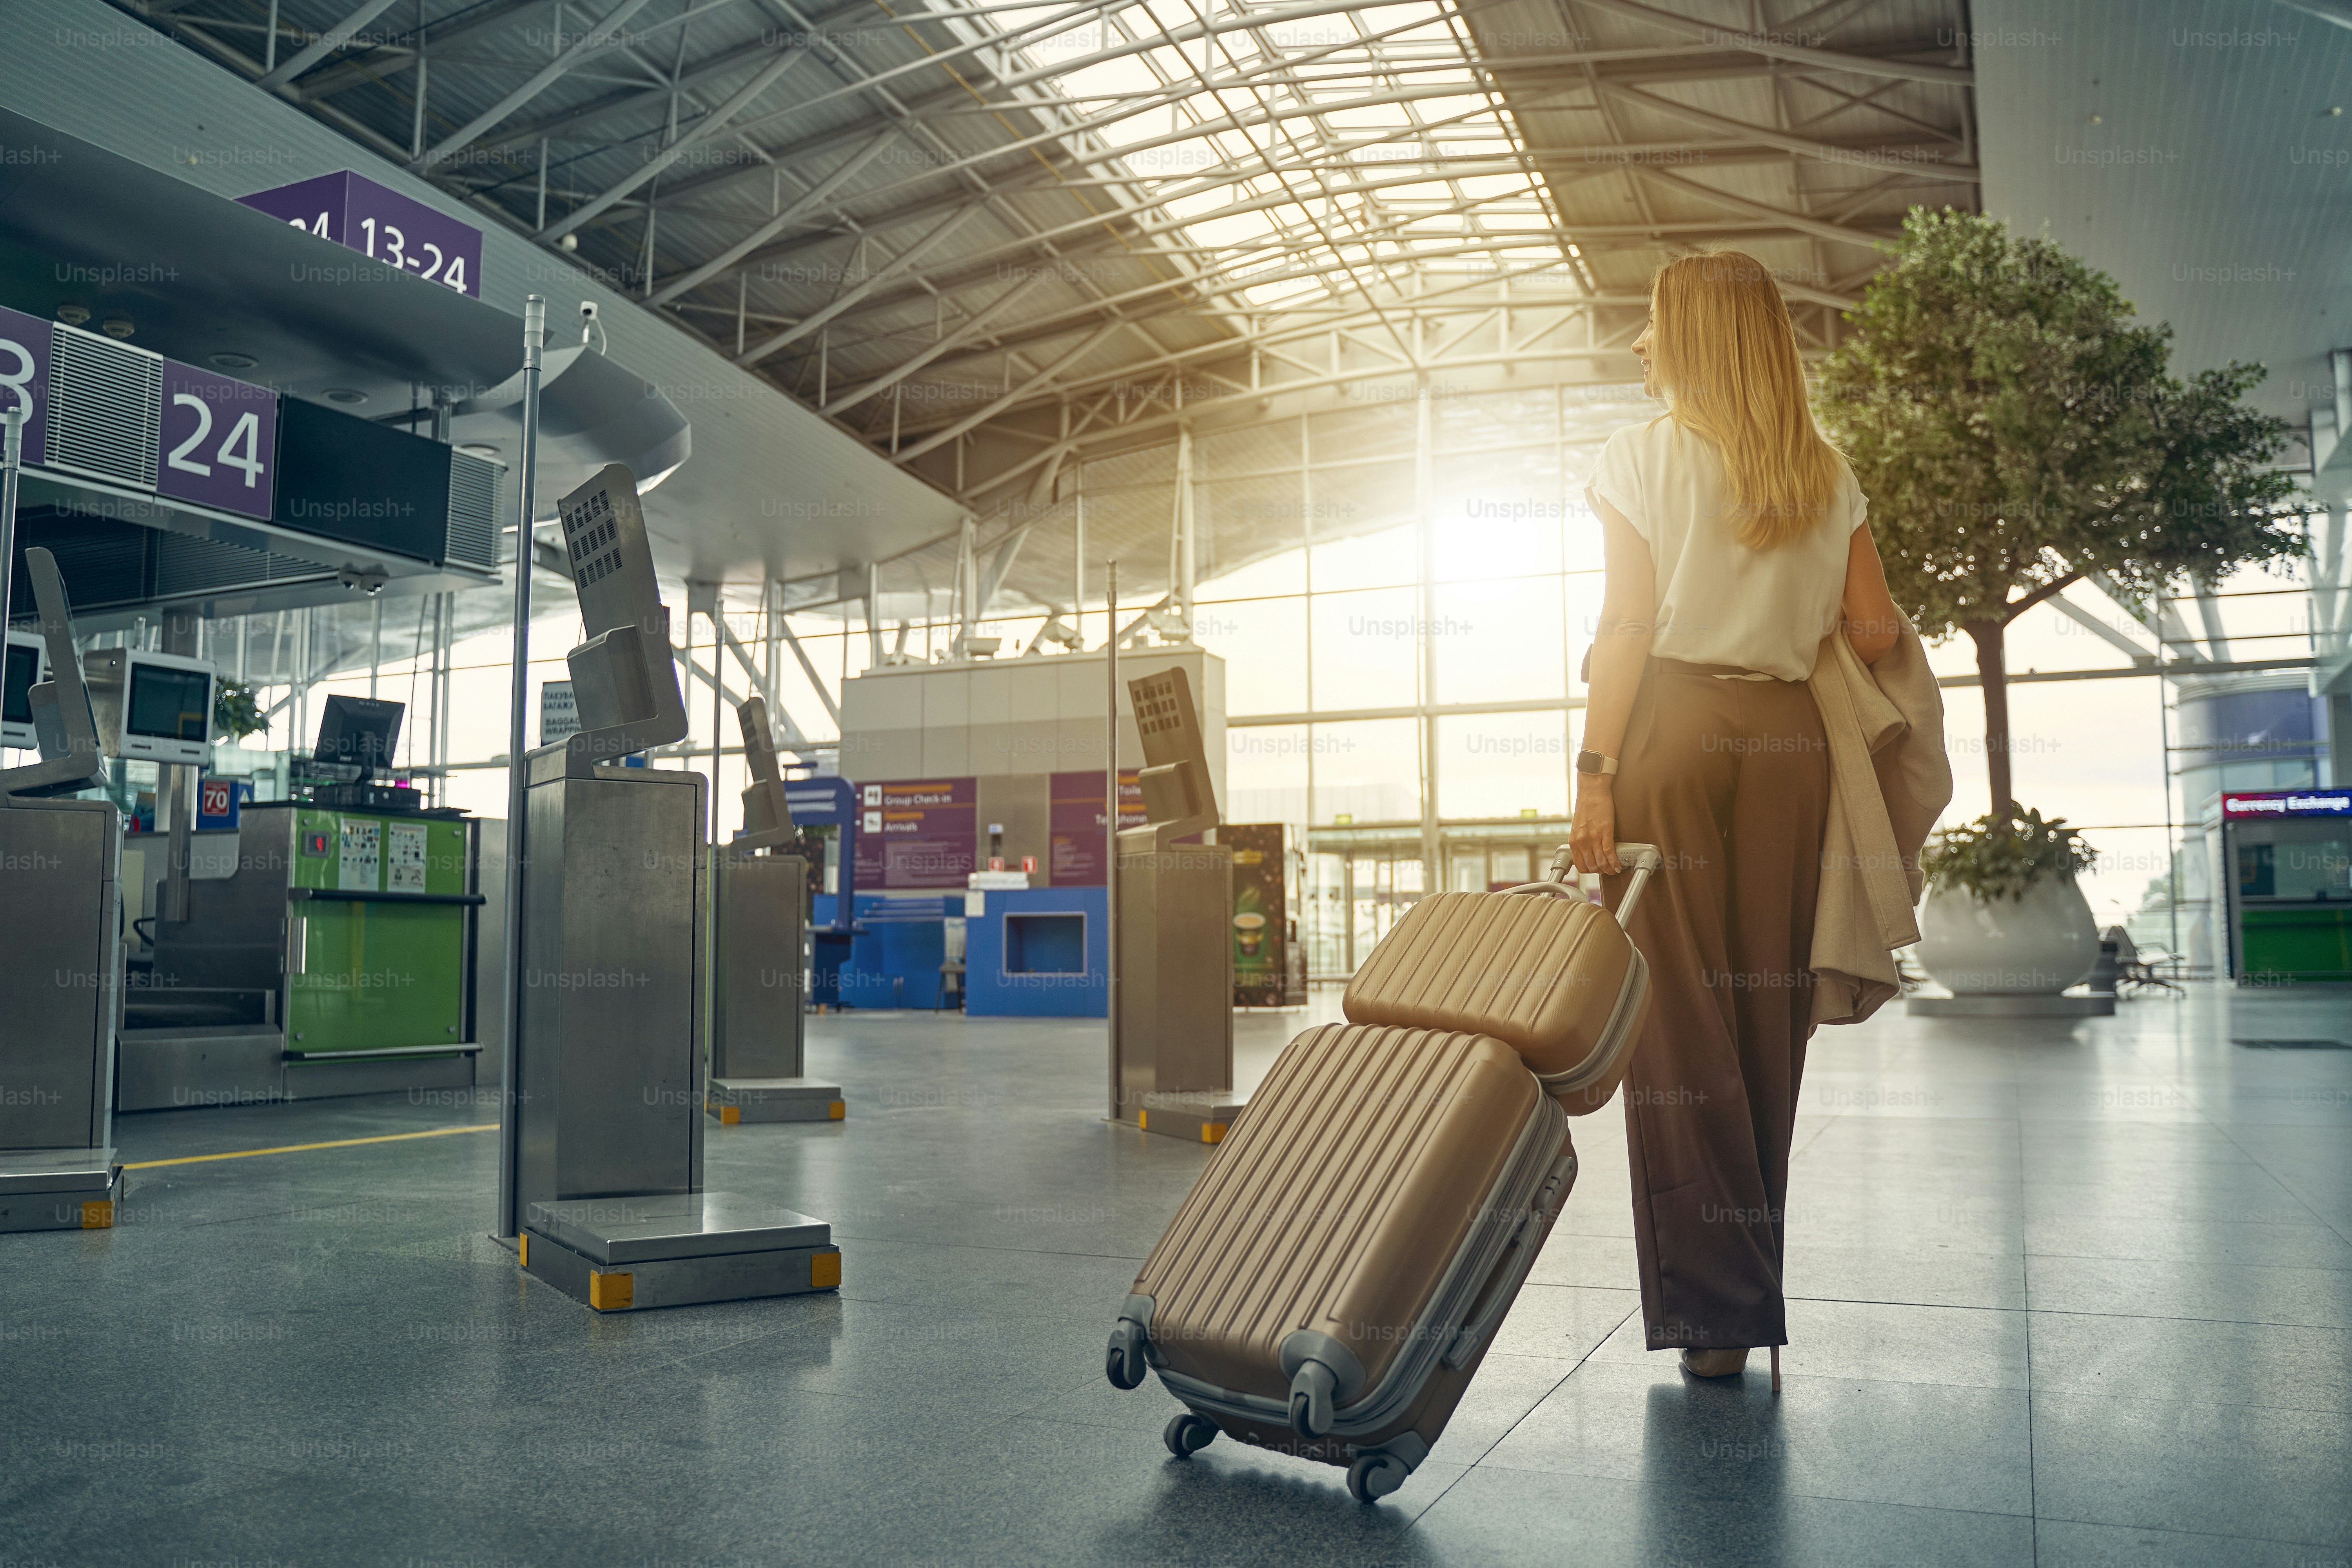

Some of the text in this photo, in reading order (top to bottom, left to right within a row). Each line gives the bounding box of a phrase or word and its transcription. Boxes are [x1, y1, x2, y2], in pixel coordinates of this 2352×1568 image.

[361, 217, 467, 294] 13-24
[168, 393, 264, 488] 24
[544, 691, 574, 700] ПАКУВА
[545, 726, 582, 735] WRAPPIN
[1119, 785, 1142, 796] Toile
[206, 790, 227, 809] 70
[884, 793, 952, 808] Group Check-in
[2226, 796, 2350, 813] Currency Exchange
[884, 821, 918, 832] Arrivals
